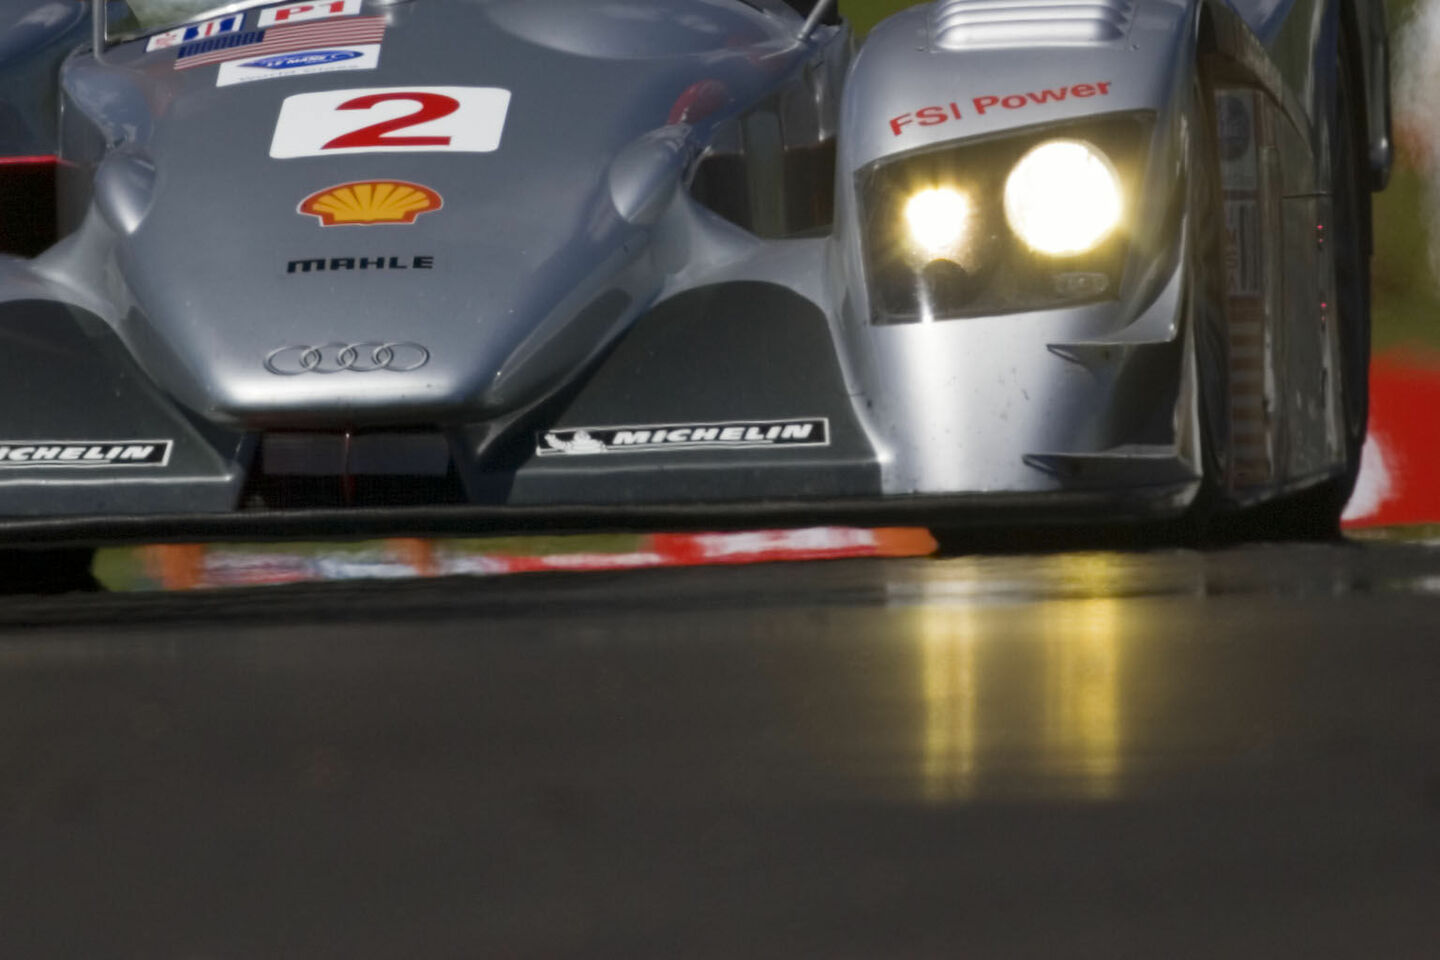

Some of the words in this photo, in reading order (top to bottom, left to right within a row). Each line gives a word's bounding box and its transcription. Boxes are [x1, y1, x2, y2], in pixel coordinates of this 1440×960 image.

[274, 1, 345, 22] P1
[889, 102, 963, 136] FSI
[972, 80, 1112, 115] Power
[320, 92, 461, 150] 2
[287, 256, 435, 274] MAHLE
[612, 424, 813, 445] MICHELIN
